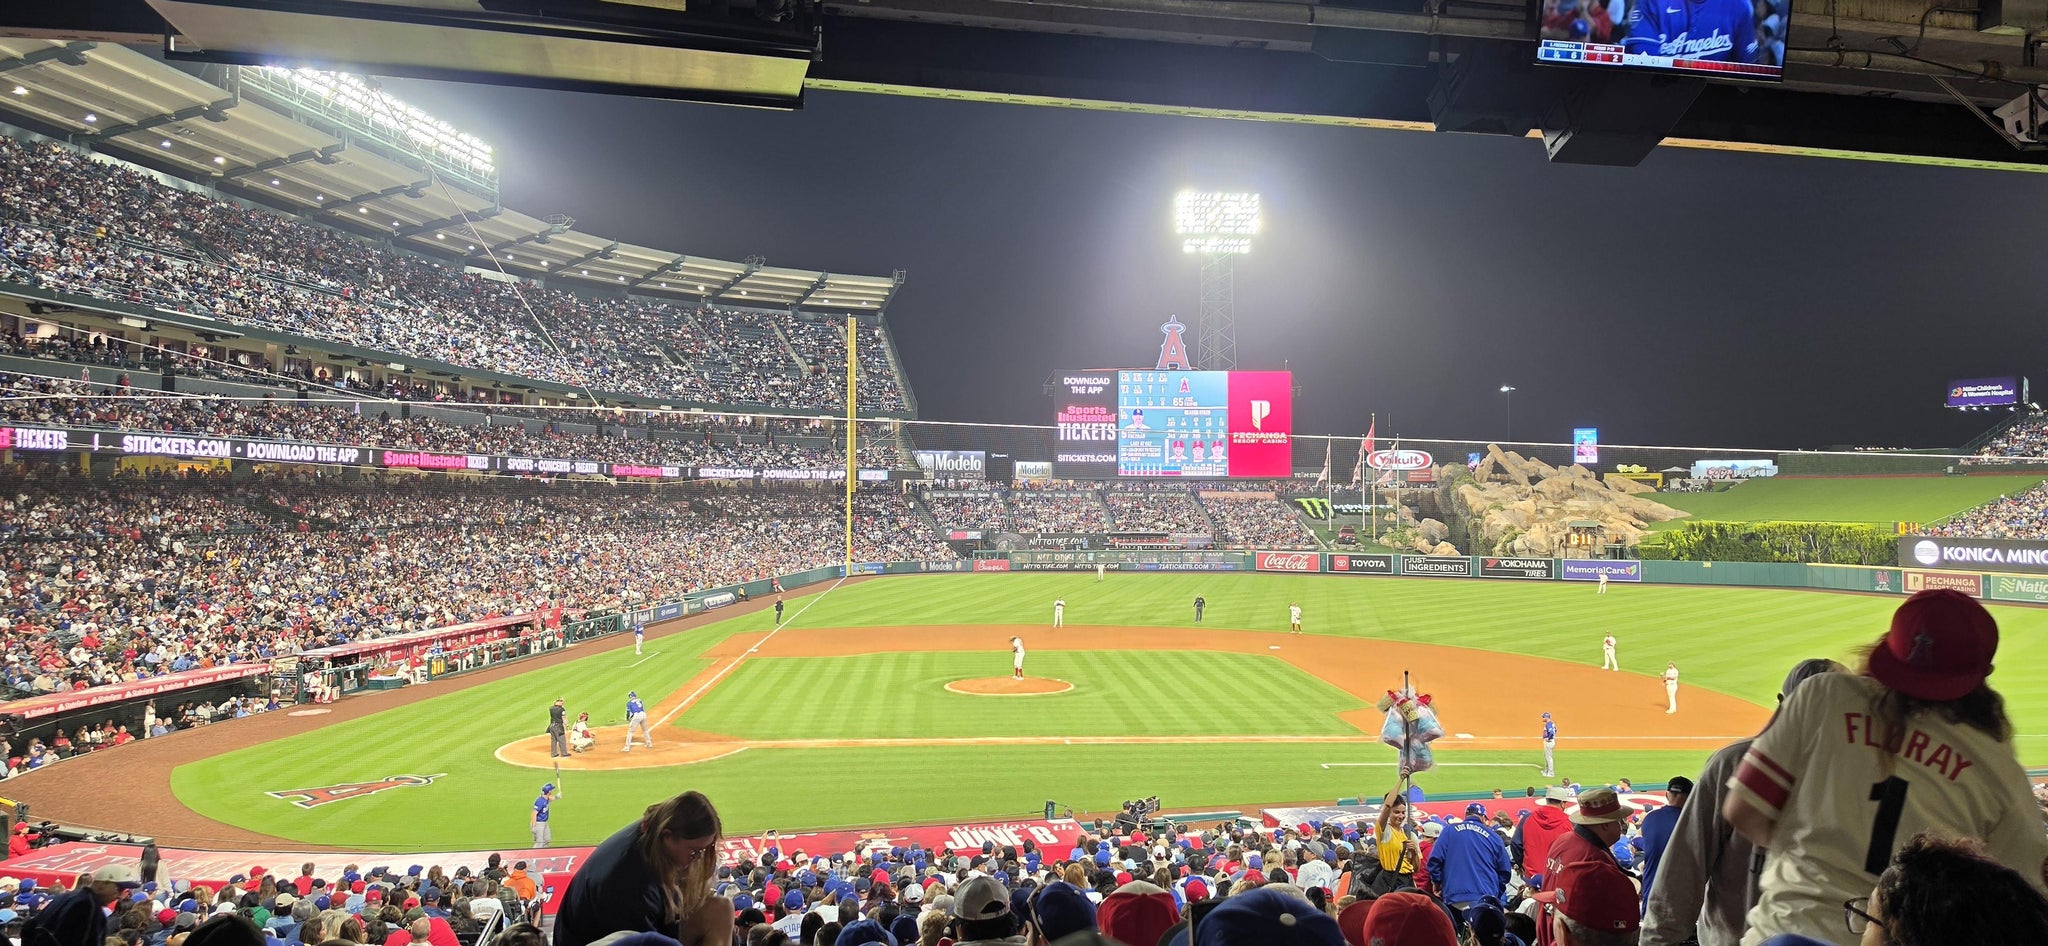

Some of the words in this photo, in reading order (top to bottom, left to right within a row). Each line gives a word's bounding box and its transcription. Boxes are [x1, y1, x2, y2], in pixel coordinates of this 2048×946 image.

[1156, 314, 1192, 370] A
[1172, 397, 1184, 406] 65
[1068, 406, 1106, 414] Sports
[1058, 412, 1116, 422] Illustrated
[1058, 423, 1116, 440] TICKETS
[15, 428, 67, 450] TICKETS
[122, 435, 230, 456] SITICKETS.COM
[247, 443, 316, 461] DOWNLOAD
[317, 447, 337, 461] THE
[338, 448, 358, 463] APP
[384, 451, 419, 467] Sports
[420, 452, 466, 468] Illustrated
[467, 456, 488, 468] TICKETS
[508, 458, 533, 470] SPORTS
[538, 460, 571, 472] CONCERTS
[574, 462, 598, 473] THEATER
[935, 454, 982, 470] Modelo
[699, 468, 753, 478] SITICKETS.COM
[763, 469, 810, 479] DOWNLOAD
[812, 470, 827, 479] THE
[828, 470, 845, 479] APP
[1021, 465, 1048, 474] Modelo
[1943, 546, 2004, 563] KONICA
[930, 562, 953, 571] Modelo
[1264, 553, 1309, 570] Coca-Cola
[1351, 560, 1386, 568] TOYOTA
[1408, 563, 1464, 572] INGREDIENTS
[1500, 560, 1546, 568] YOKOHAMA
[1566, 566, 1626, 574] MemorialCare
[1925, 577, 1975, 587] PECHANGA
[952, 823, 1031, 832] Monday
[1467, 824, 1490, 838] ANGELES
[1864, 775, 1910, 876] 1
[944, 828, 1024, 849] JUNE
[1028, 826, 1059, 844] 8
